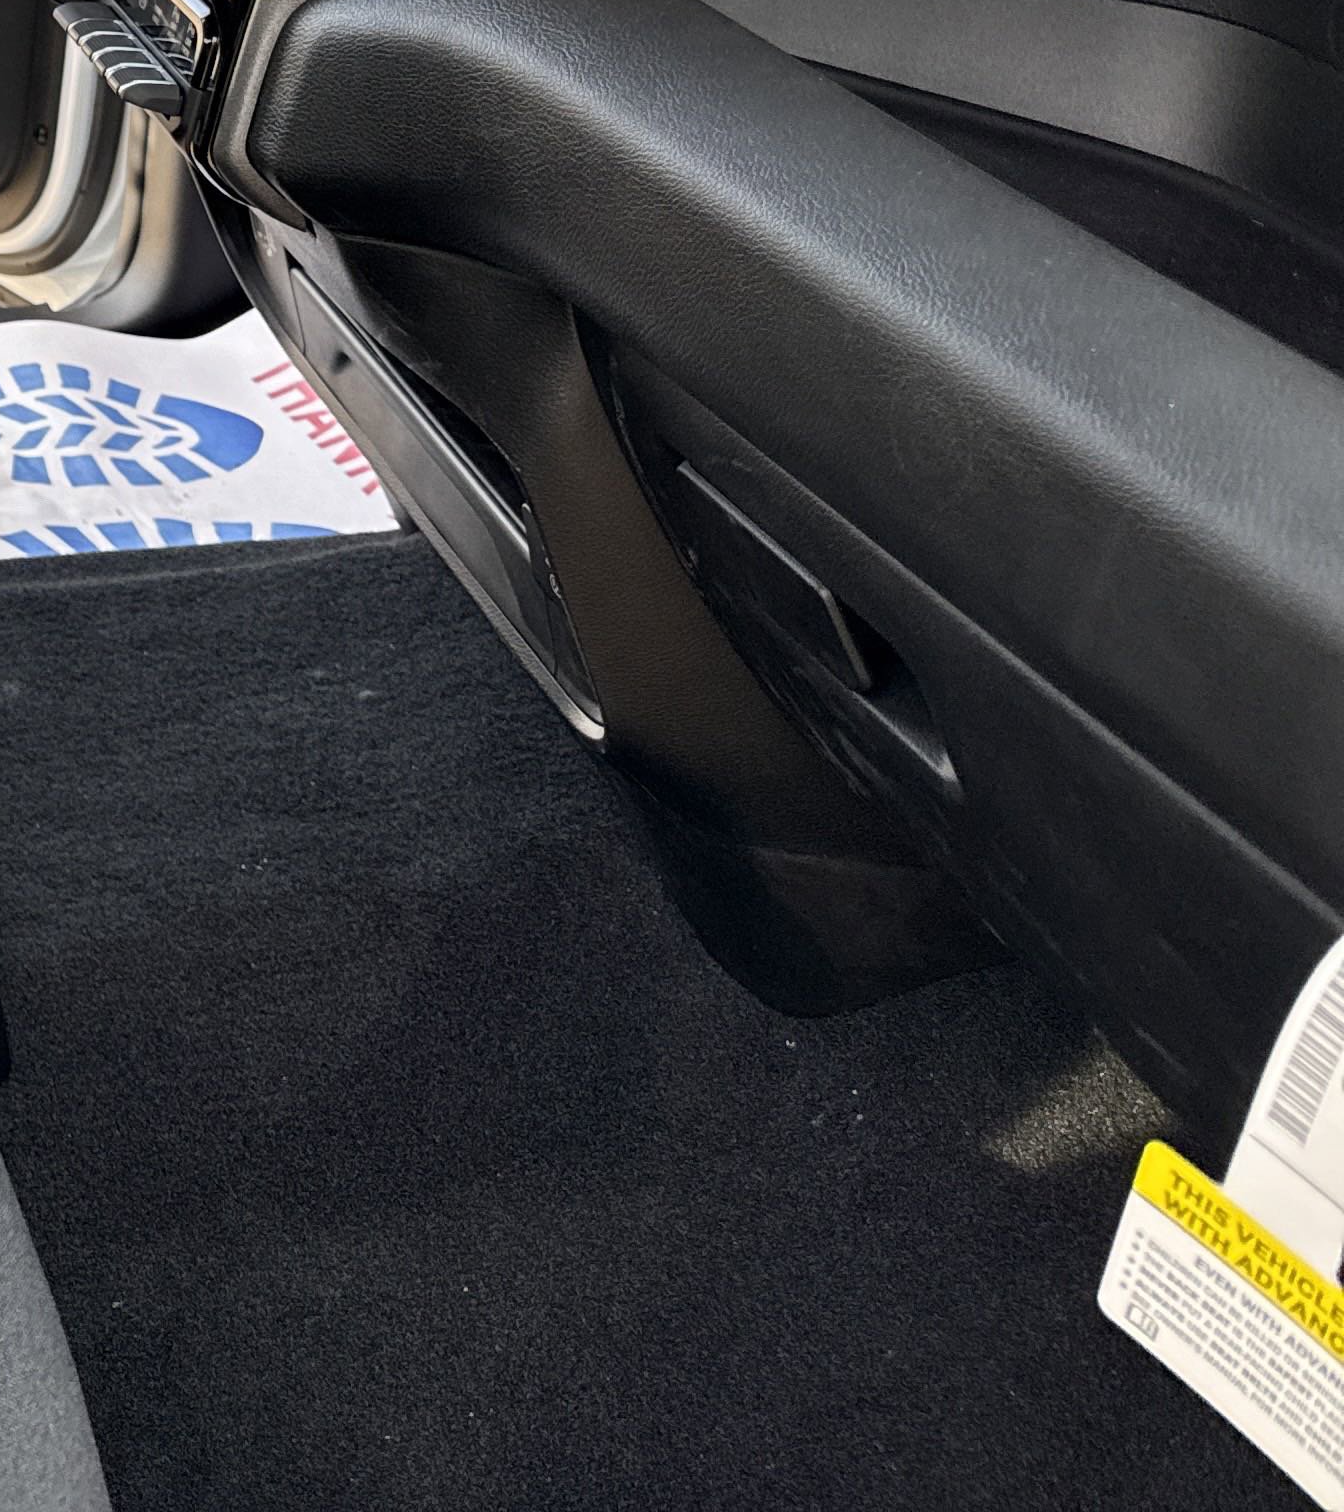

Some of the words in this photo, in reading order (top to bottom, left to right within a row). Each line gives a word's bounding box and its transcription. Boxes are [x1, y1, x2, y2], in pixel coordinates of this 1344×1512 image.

[1164, 1189, 1231, 1256] WITH
[1170, 1169, 1230, 1228] THIS
[1236, 1220, 1344, 1328] VEHICLE
[1195, 1255, 1236, 1298] EVEN
[1239, 1292, 1281, 1336] WITH
[1286, 1333, 1344, 1393] ADVAN
